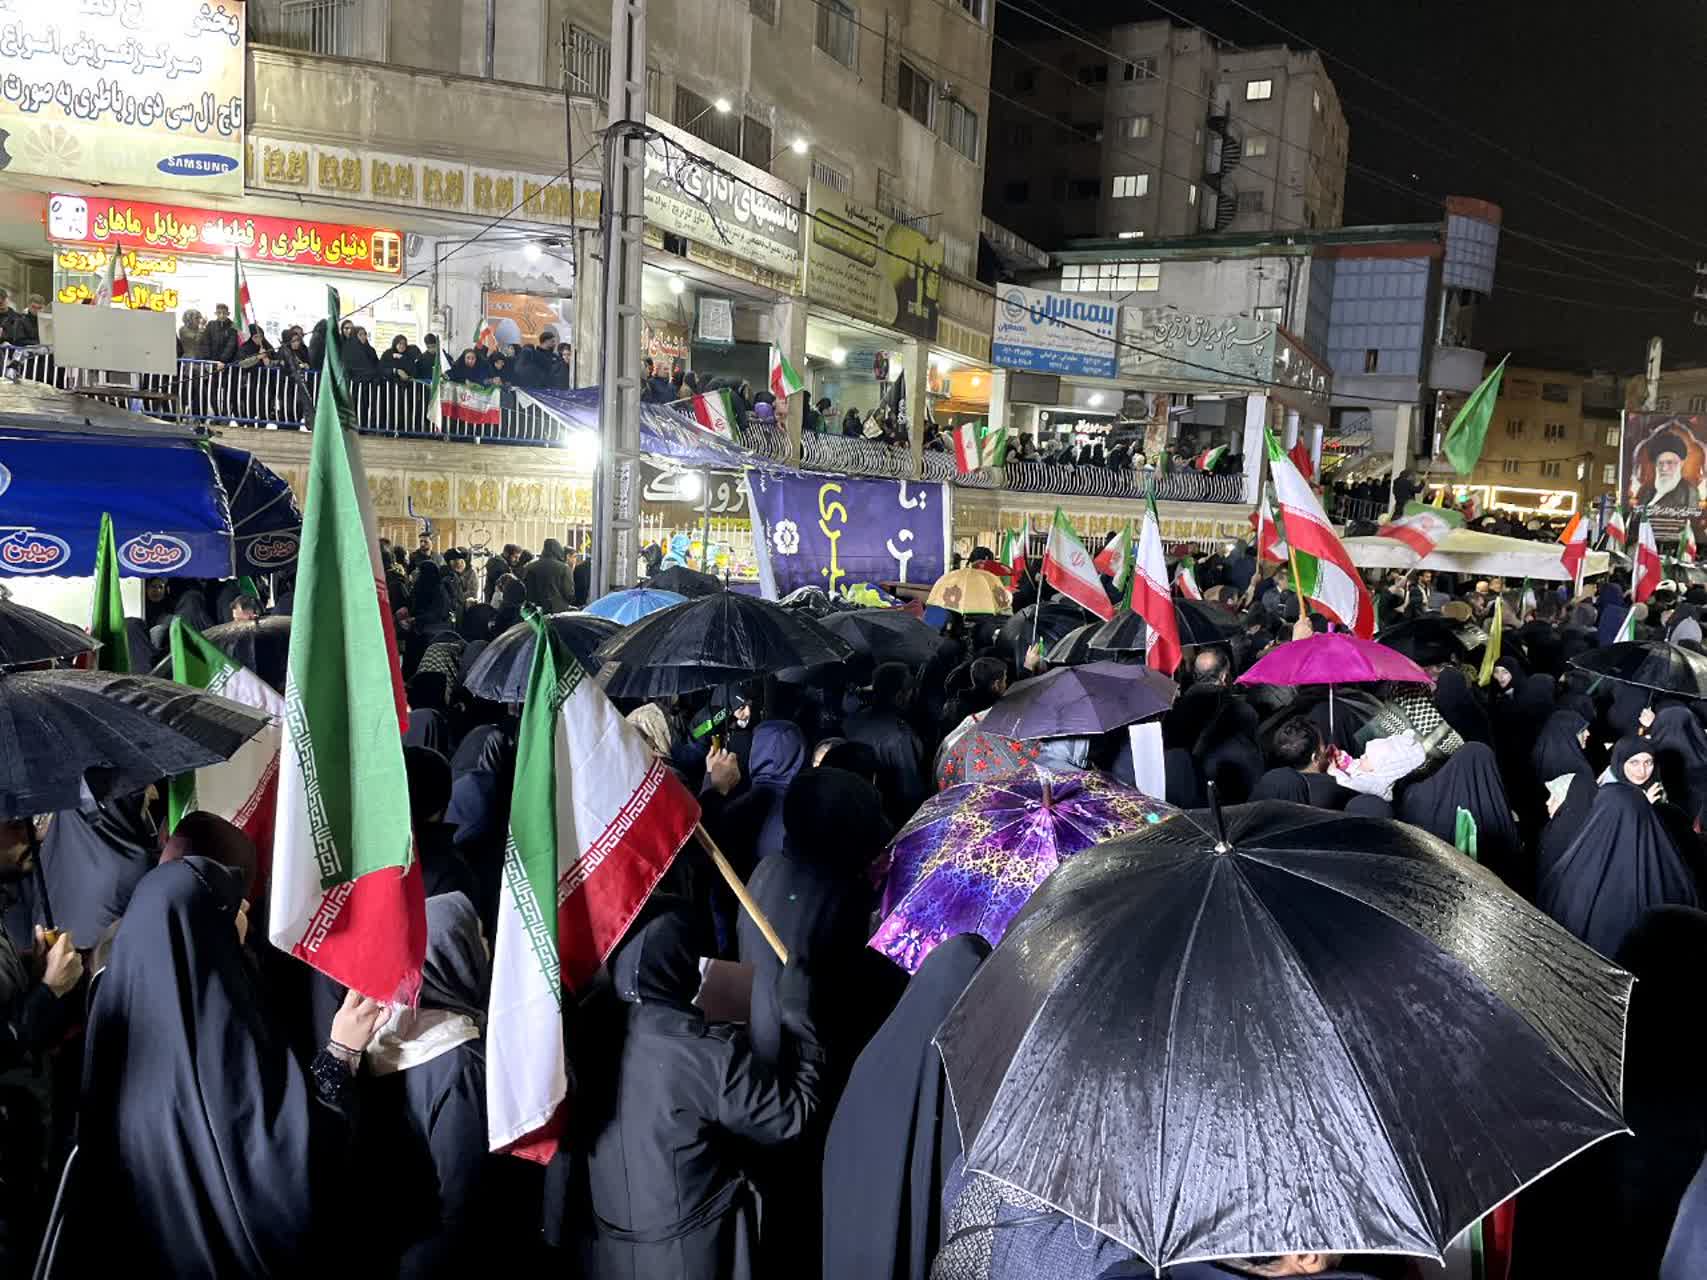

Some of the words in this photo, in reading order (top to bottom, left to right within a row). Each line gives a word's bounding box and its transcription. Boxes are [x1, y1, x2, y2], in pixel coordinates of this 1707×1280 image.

[4, 73, 54, 113] صورت
[55, 79, 72, 115] به
[72, 78, 124, 121] باطری
[137, 91, 164, 126] دی
[123, 95, 136, 125] و
[165, 102, 194, 130] سی
[167, 155, 229, 173] SAMSUNG
[93, 205, 143, 241] ماهان
[146, 210, 200, 248] موبایل
[201, 217, 256, 247] قطعات
[58, 246, 107, 273] فوری
[258, 231, 269, 256] و
[271, 225, 322, 263] باطری
[325, 231, 369, 265] دنیای
[1030, 294, 1072, 328] ایران
[1072, 302, 1114, 335] بیمه
[4, 542, 60, 564] میهن
[129, 543, 182, 564] میهن
